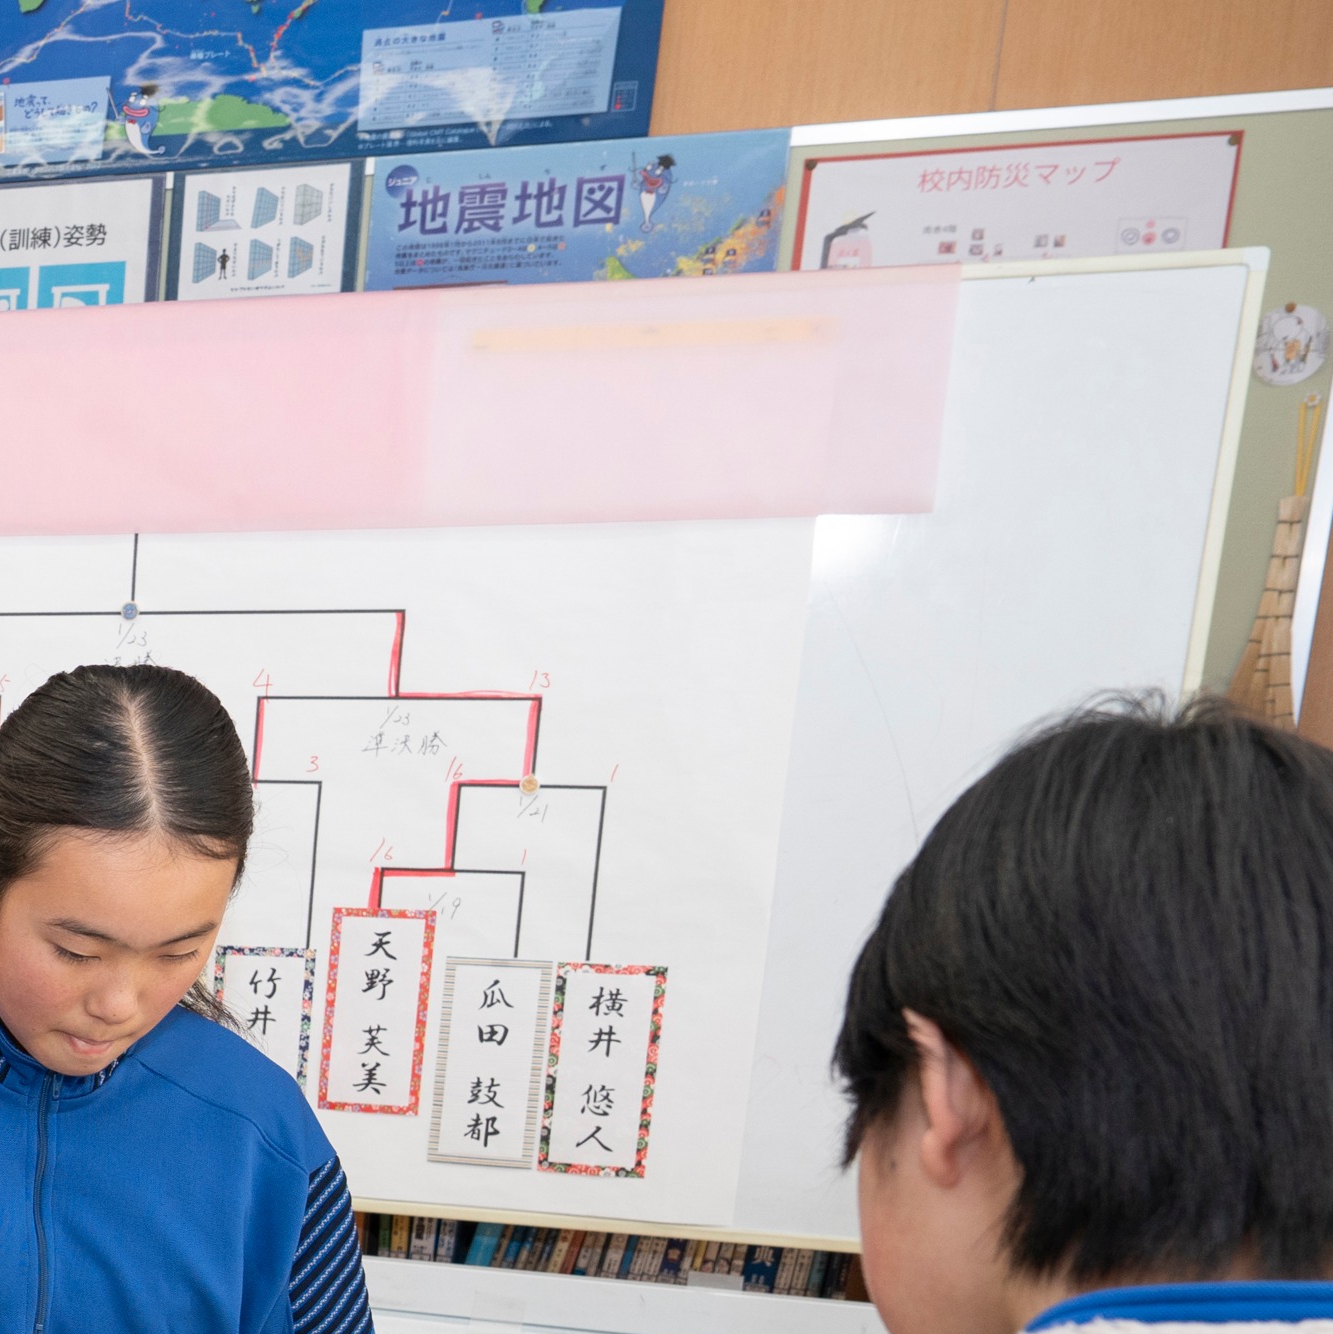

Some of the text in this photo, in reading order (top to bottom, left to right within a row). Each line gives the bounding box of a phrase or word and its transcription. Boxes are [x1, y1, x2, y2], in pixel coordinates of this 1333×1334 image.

[388, 175, 419, 188] ジュニア
[917, 156, 1122, 194] 校内防災マップ
[398, 174, 626, 235] 地震地図
[252, 668, 552, 704] 4 13
[306, 755, 320, 773] 3
[360, 729, 449, 756] 準決勝
[247, 968, 282, 1036] 竹井
[353, 931, 397, 1095] 天野 芙美
[463, 979, 514, 1148] 瓜田 鼓都
[575, 986, 628, 1153] 横井 悠人
